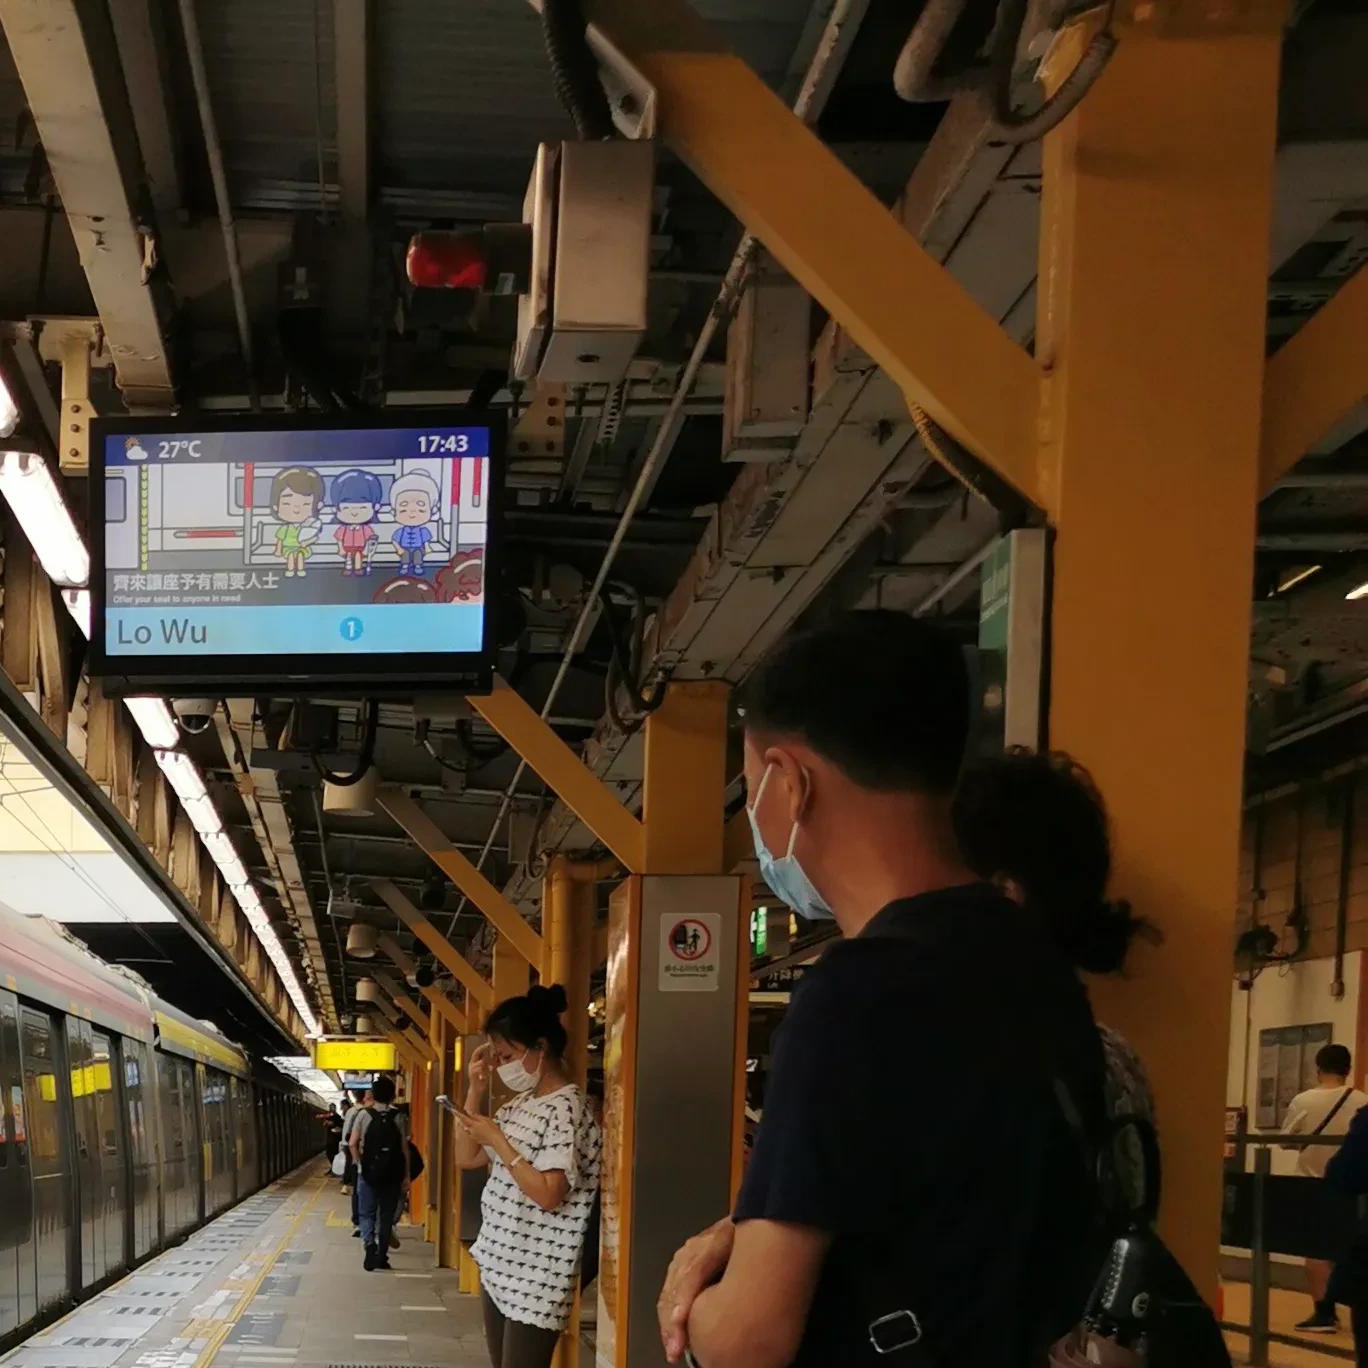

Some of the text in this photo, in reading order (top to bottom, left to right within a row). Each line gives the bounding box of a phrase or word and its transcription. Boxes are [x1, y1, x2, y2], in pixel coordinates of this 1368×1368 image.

[158, 440, 202, 459] 27°C
[417, 435, 469, 453] 17:43
[118, 618, 207, 645] Lo Wu
